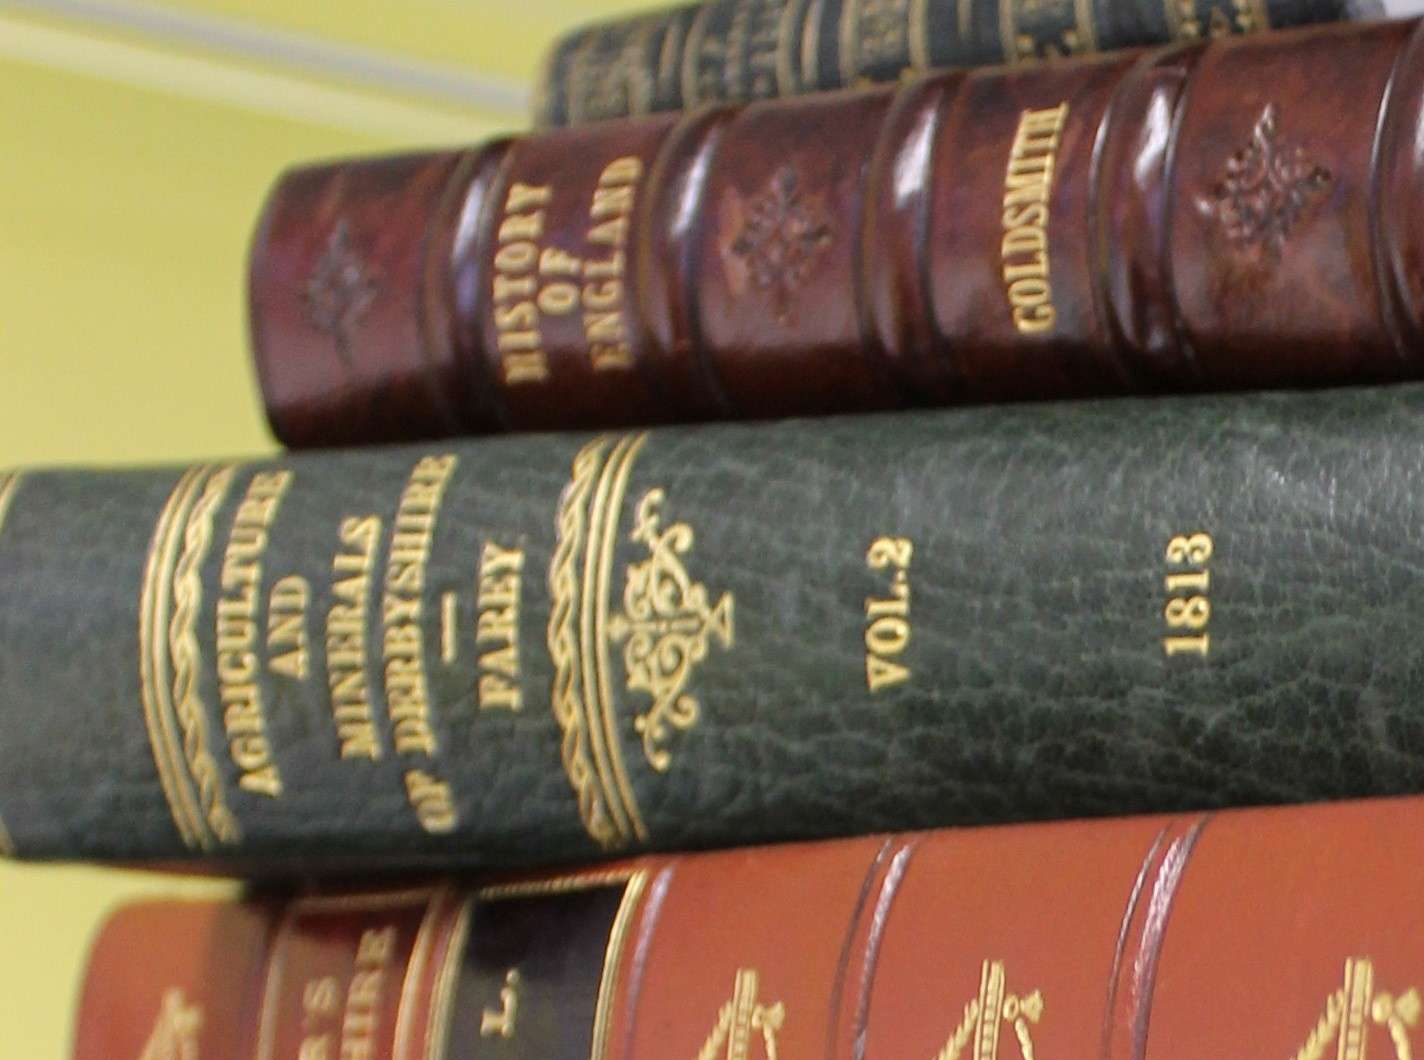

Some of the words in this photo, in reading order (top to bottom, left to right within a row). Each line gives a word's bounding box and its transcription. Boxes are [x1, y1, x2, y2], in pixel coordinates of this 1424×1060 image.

[493, 182, 552, 385] HISTORY
[537, 247, 581, 316] OF
[582, 155, 643, 370] ENGLAND
[1002, 101, 1069, 335] GOLDSMITH
[215, 469, 294, 798] AGRICULTURE
[266, 574, 311, 681] AND
[326, 514, 383, 762] MINERALS
[382, 453, 458, 756] DERBYSHIRE
[476, 540, 525, 712] FAREY
[1163, 532, 1214, 657] 1813
[404, 769, 461, 834] OF
